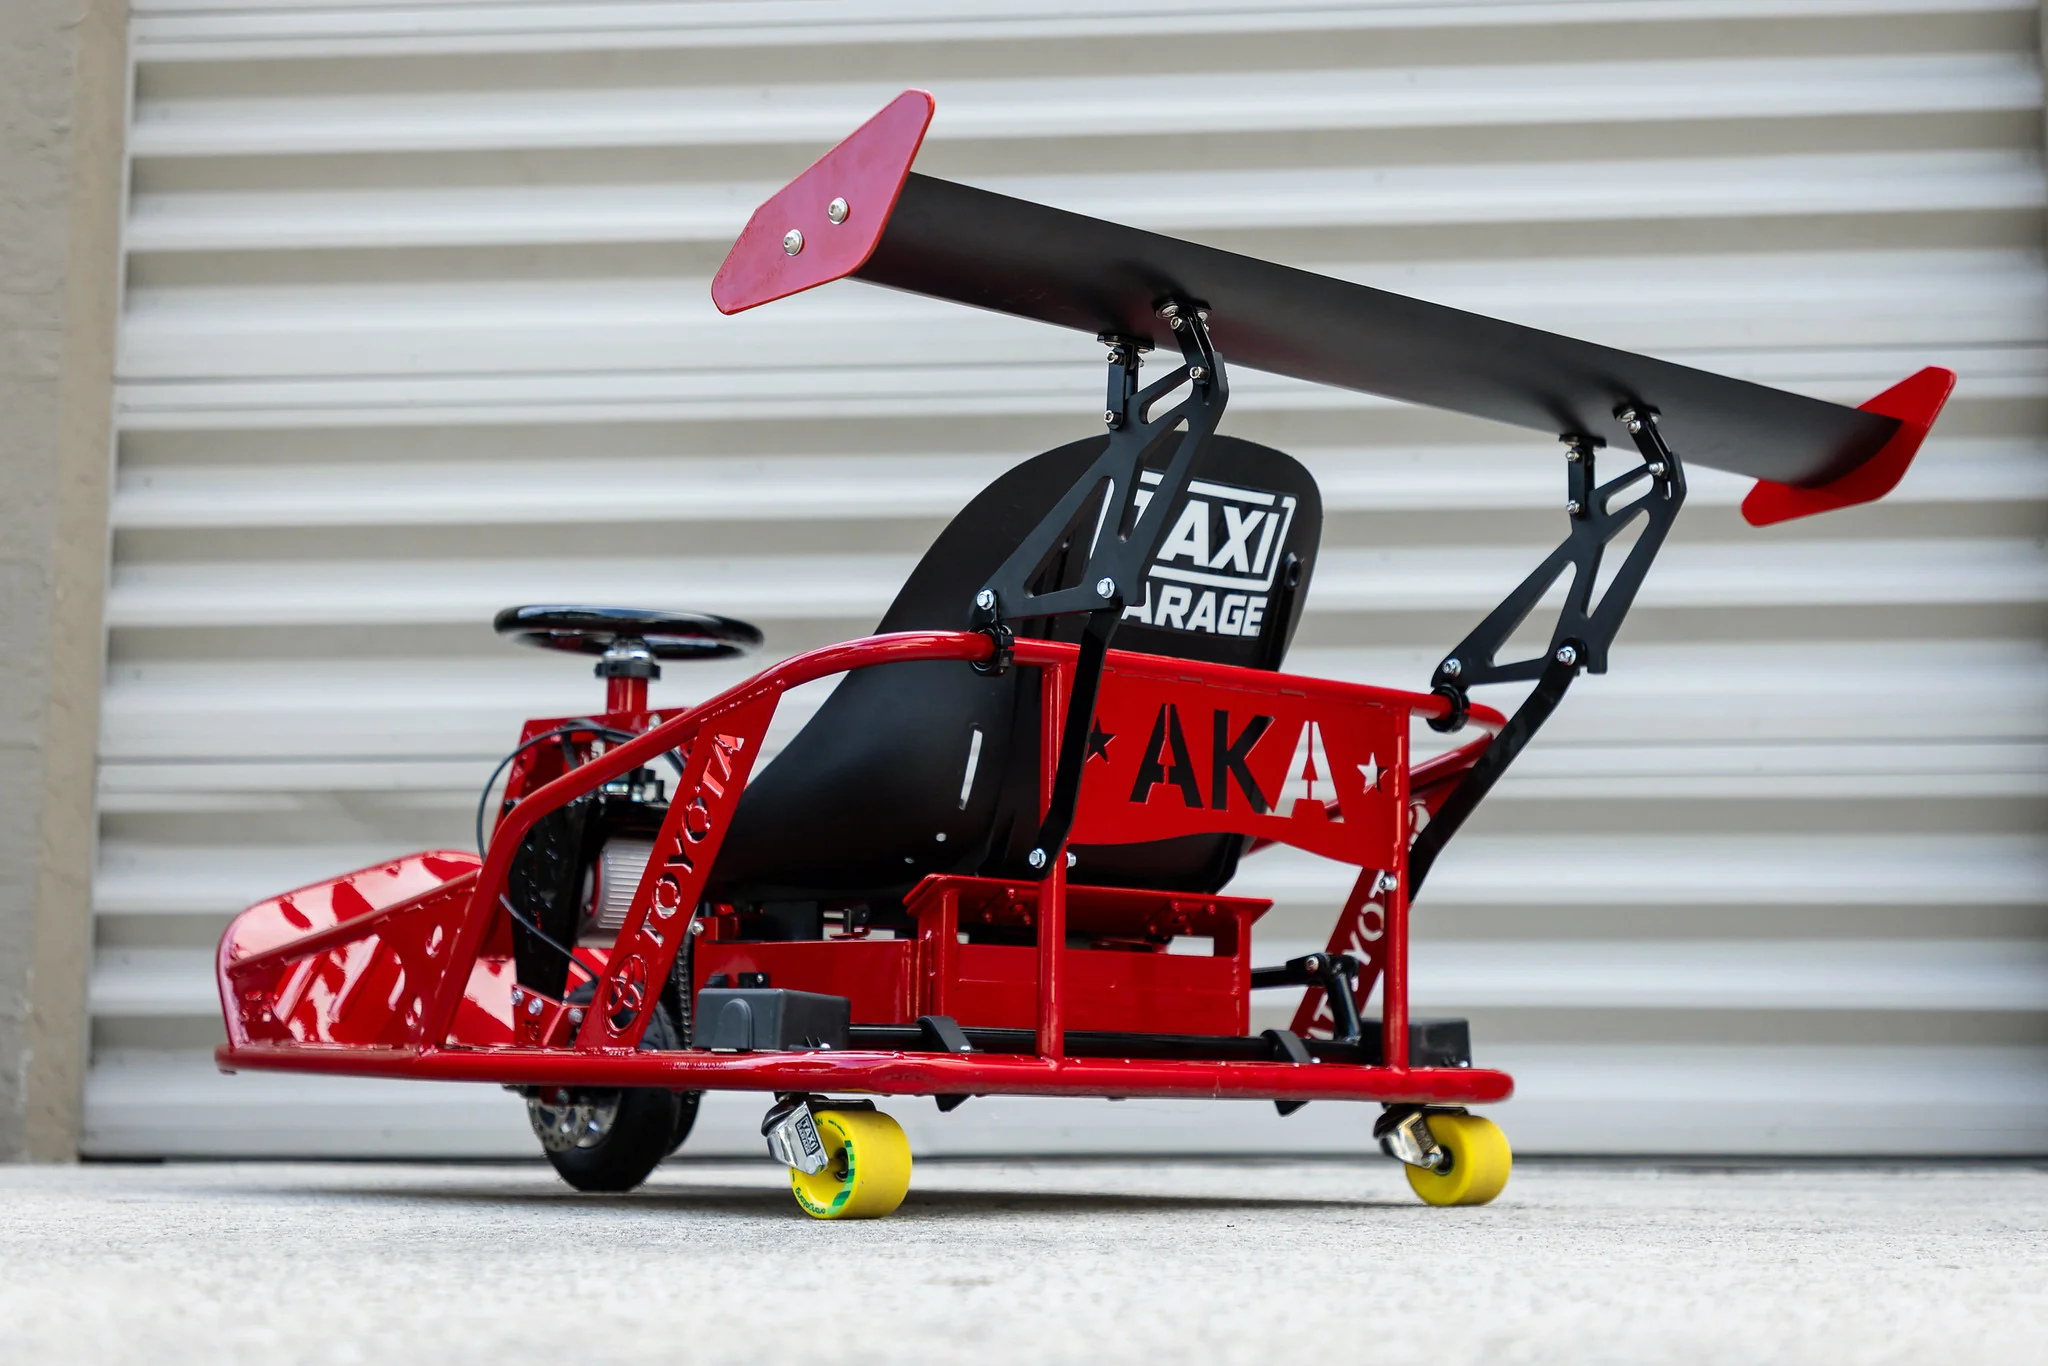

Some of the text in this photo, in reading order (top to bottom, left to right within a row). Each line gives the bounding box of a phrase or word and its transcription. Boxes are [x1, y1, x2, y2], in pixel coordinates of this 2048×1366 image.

[1121, 581, 1268, 637] ARAGE
[1129, 703, 1345, 823] AKA
[635, 733, 745, 947] TOYOTA
[802, 1119, 819, 1151] TAXI
